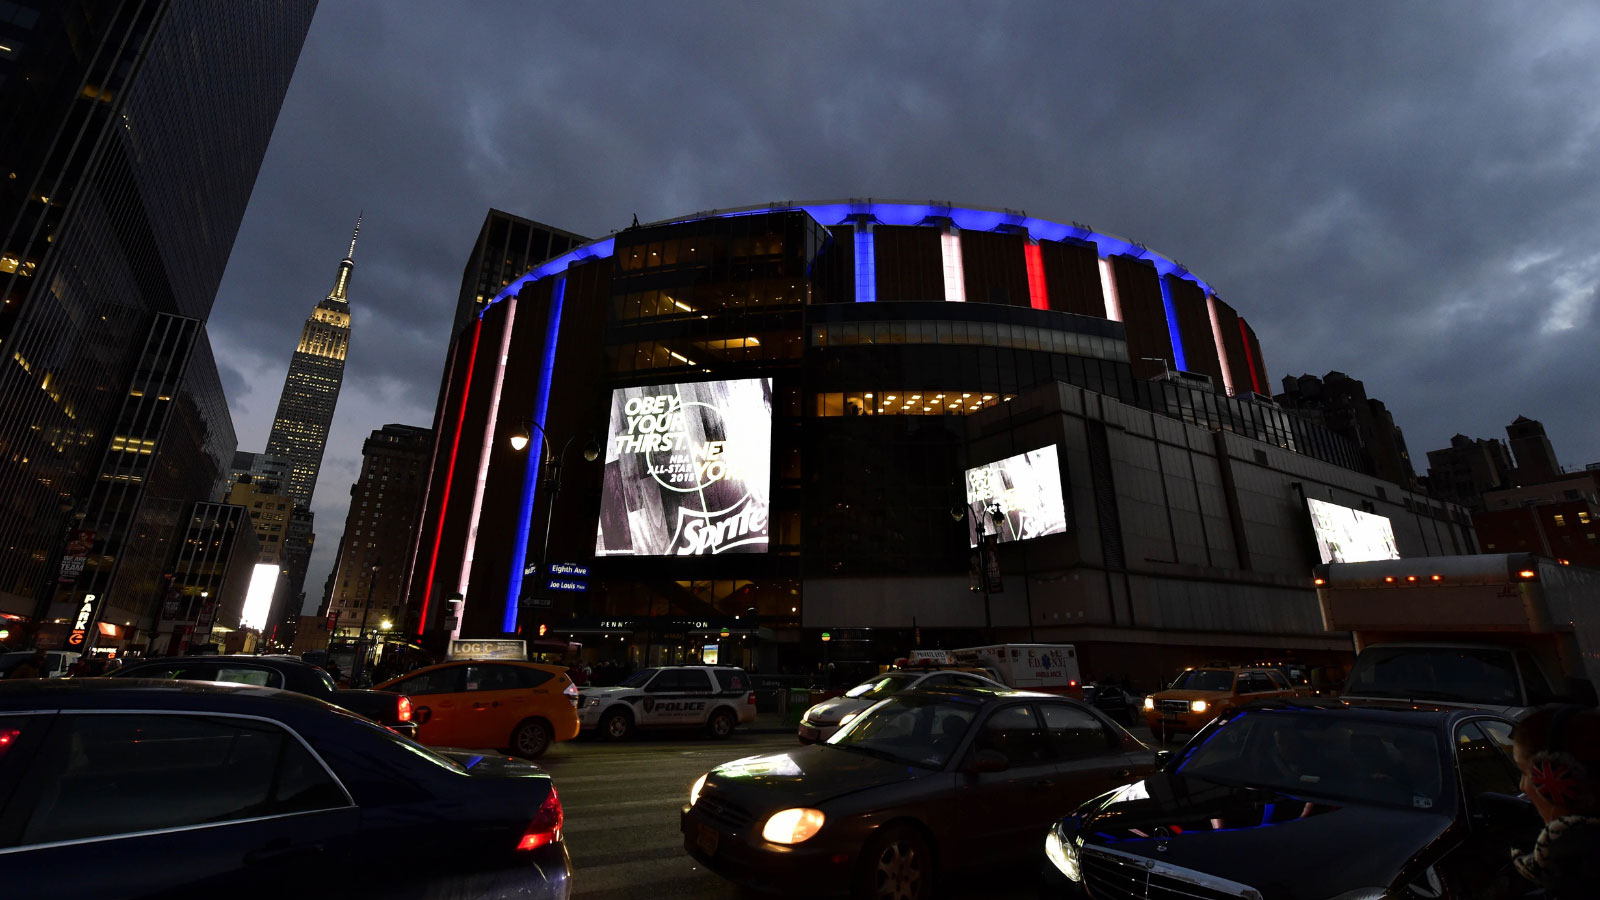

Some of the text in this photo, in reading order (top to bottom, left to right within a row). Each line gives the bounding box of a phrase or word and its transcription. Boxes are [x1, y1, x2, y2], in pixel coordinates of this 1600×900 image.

[625, 395, 681, 415] OBEY
[627, 413, 687, 434] YOUR
[614, 432, 688, 454] THIRST.
[669, 455, 690, 464] NBA
[647, 463, 693, 474] ALL-STAR
[670, 473, 695, 482] 2015
[677, 499, 768, 555] Sprite
[552, 564, 573, 574] Eighth
[573, 566, 587, 574] Ave
[560, 581, 576, 589] Louis
[75, 594, 95, 630] PARK
[655, 702, 705, 711] POLICE
